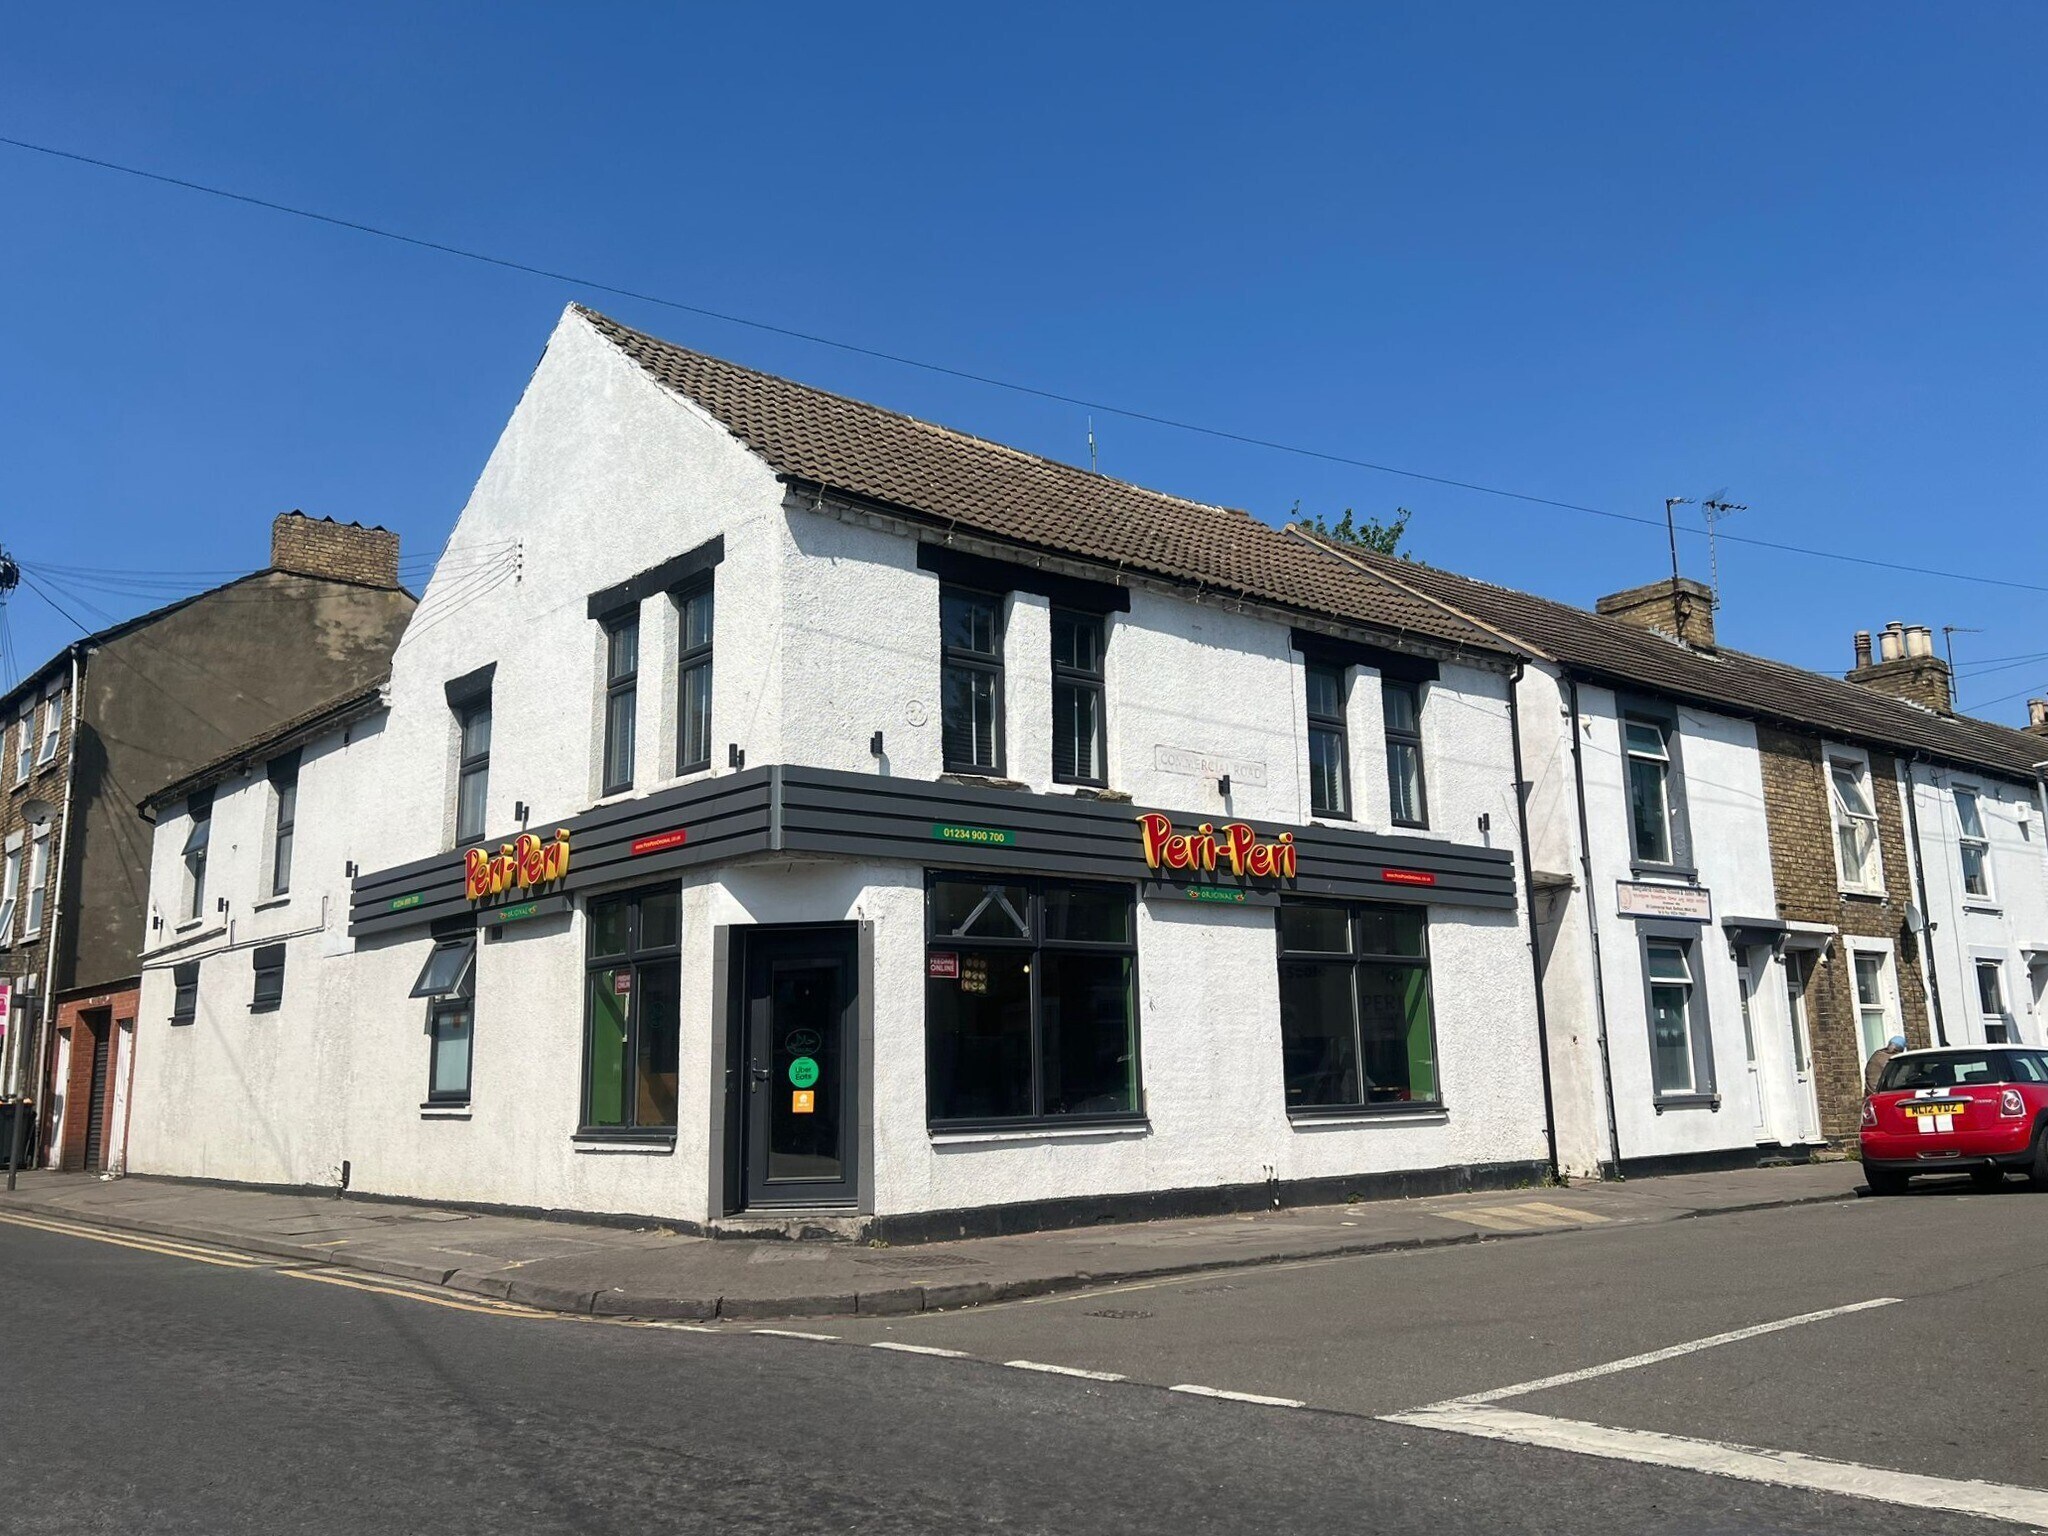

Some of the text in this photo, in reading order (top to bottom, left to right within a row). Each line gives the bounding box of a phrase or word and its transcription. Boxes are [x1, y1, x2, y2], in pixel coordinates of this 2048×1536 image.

[1234, 764, 1261, 779] ROAD
[943, 827, 1005, 842] 01234 900 700
[1135, 813, 1296, 878] Peri-Peri
[463, 828, 571, 900] Peri-Peri
[1201, 890, 1233, 900] ORIGINAL
[795, 1073, 812, 1081] Eats
